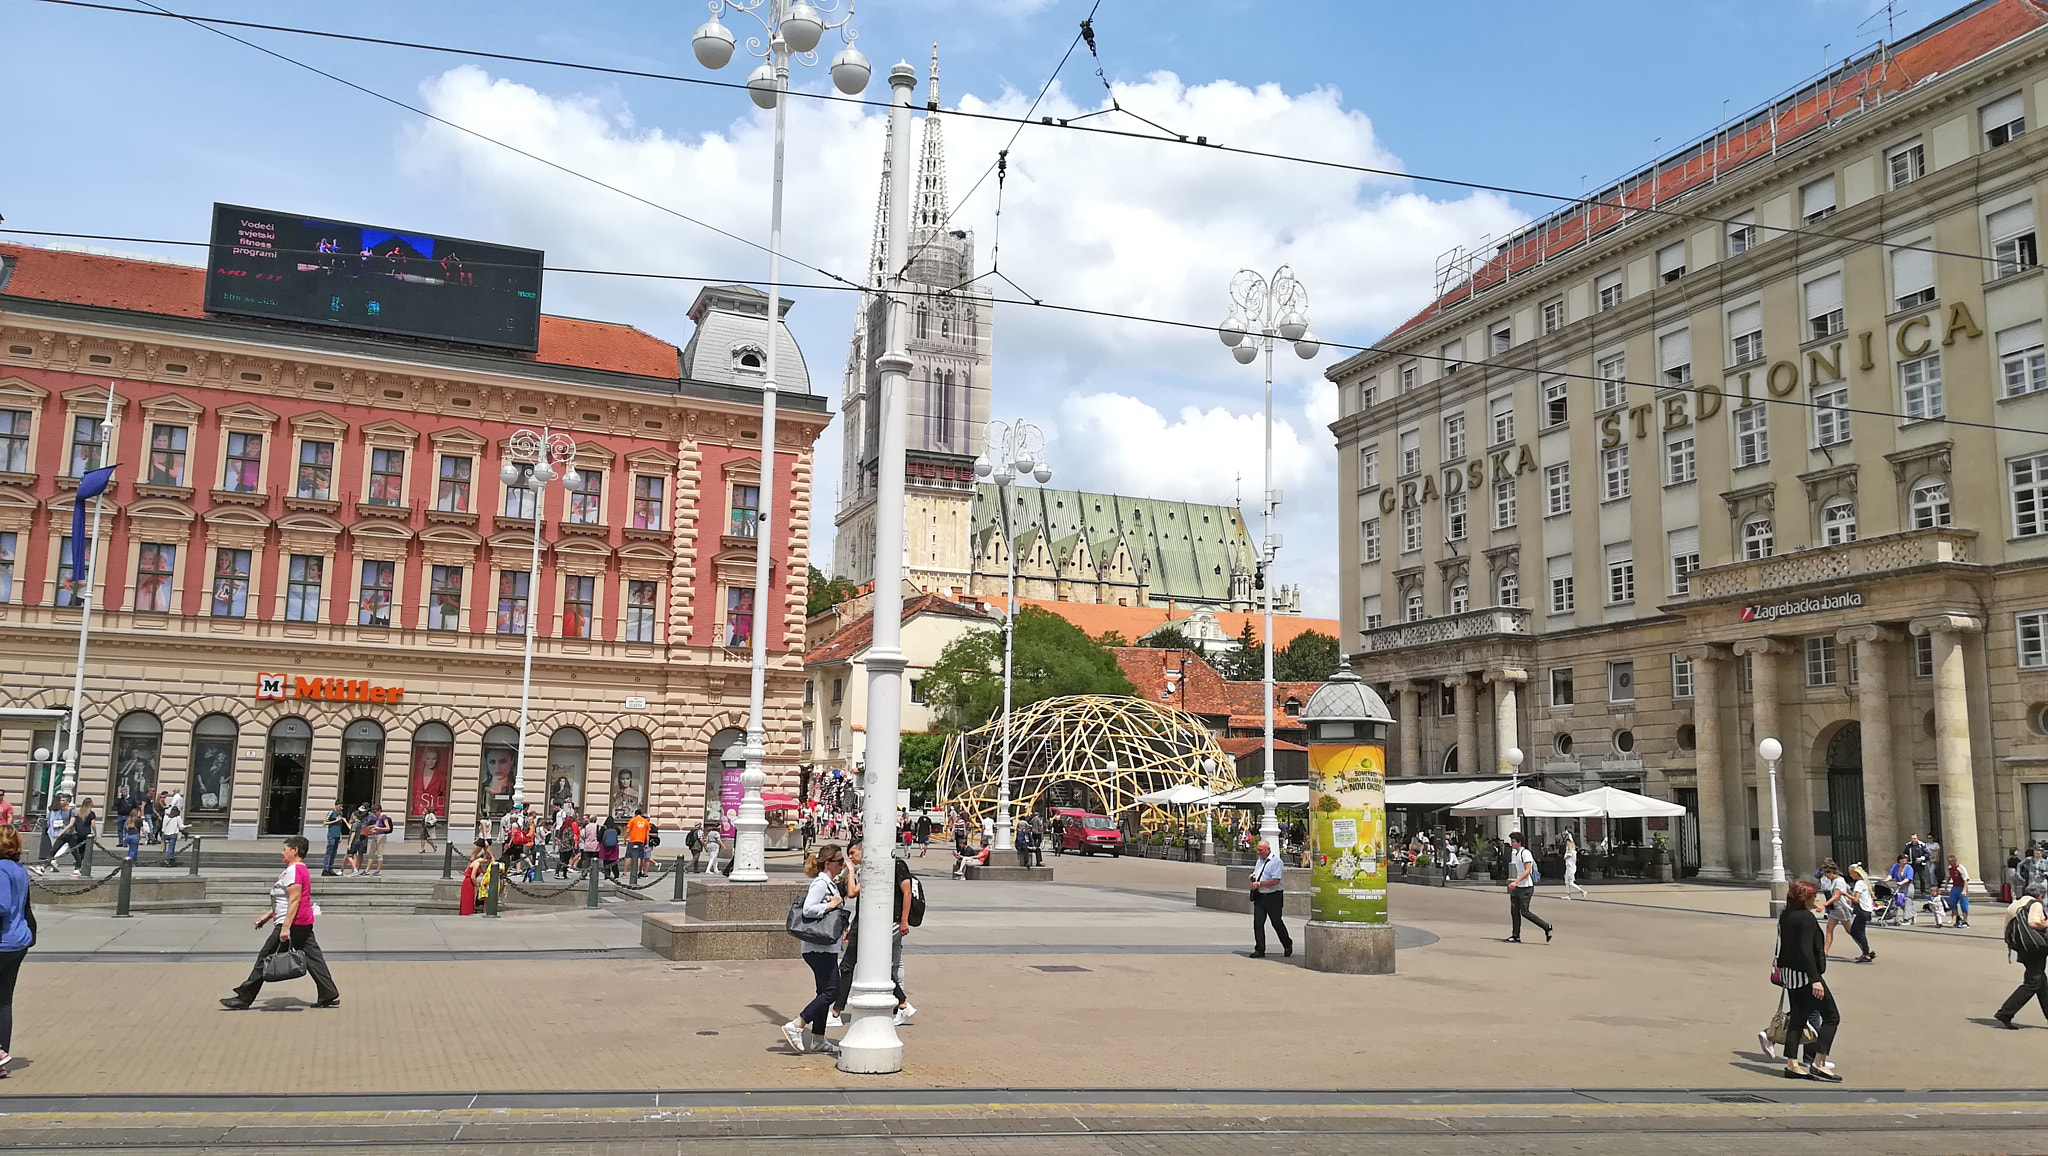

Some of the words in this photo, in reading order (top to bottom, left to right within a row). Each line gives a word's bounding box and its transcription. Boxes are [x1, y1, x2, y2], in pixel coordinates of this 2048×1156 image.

[240, 219, 275, 231] Vodeći
[238, 229, 276, 241] svjetski
[232, 247, 278, 259] programi
[1379, 443, 1538, 514] GRADSKA
[1601, 301, 1983, 448] ŠTEDIONICA
[1753, 597, 1820, 621] Zagrebačka
[1823, 591, 1862, 610] banka
[263, 680, 279, 692] M
[293, 676, 405, 703] Müller
